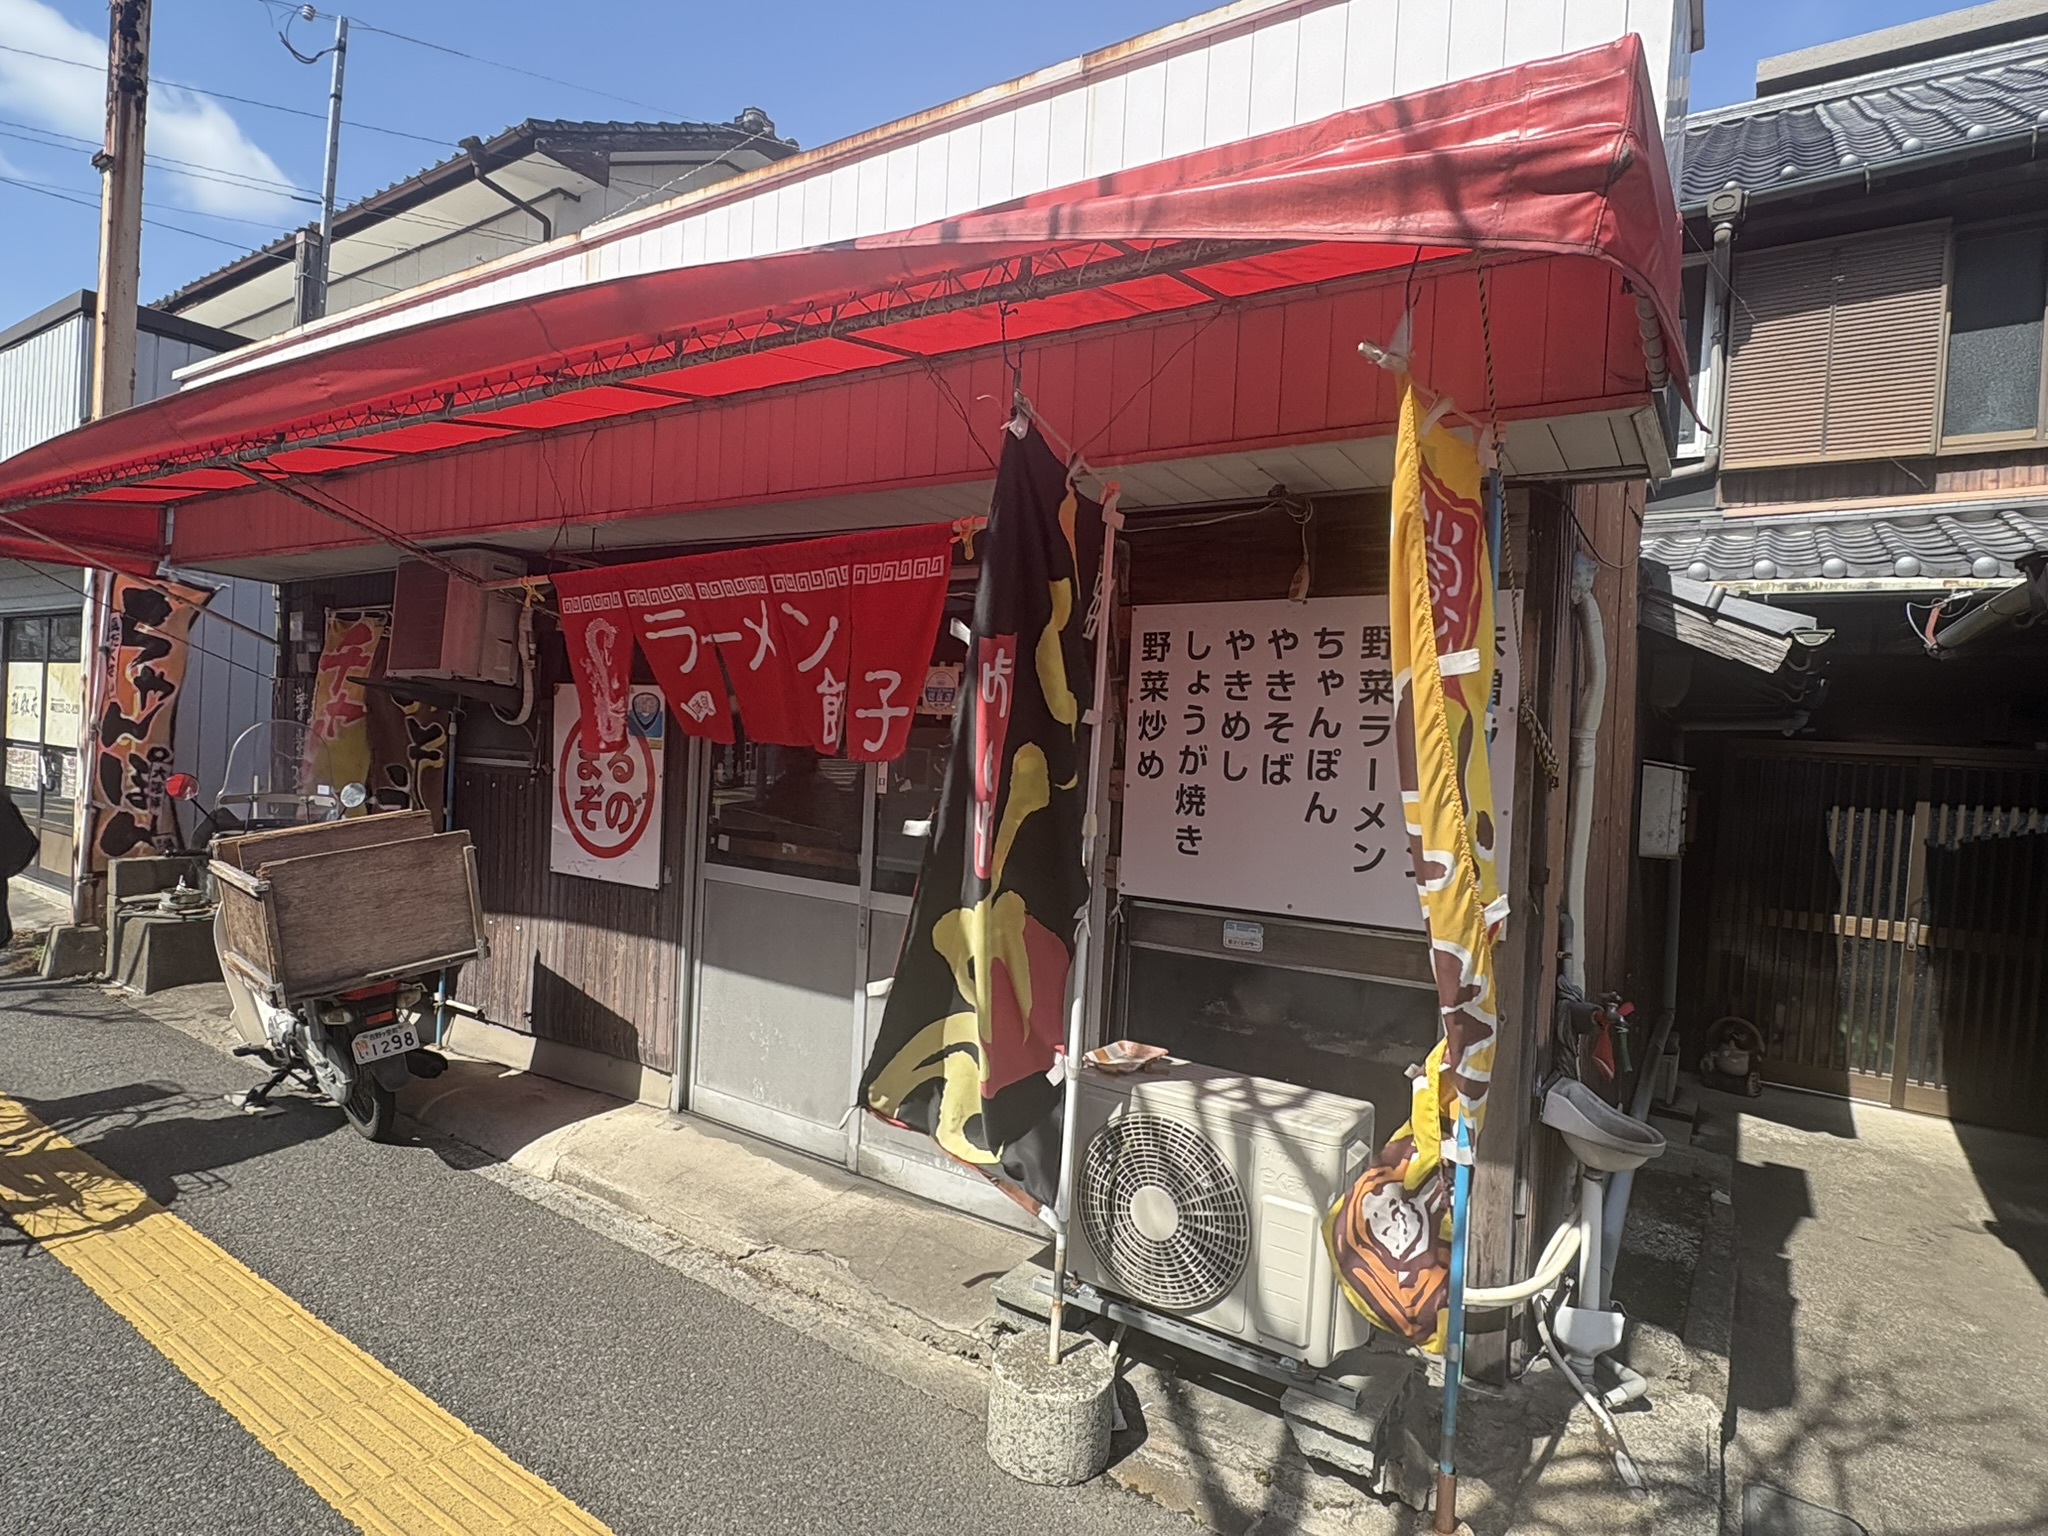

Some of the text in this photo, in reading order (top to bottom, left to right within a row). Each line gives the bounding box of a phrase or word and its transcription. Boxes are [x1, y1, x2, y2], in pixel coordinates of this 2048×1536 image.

[643, 600, 839, 674] ラーメン
[1137, 631, 1172, 780] 野菜炒め
[1220, 628, 1255, 782] やきめし
[1262, 628, 1298, 787] やきそば
[1175, 630, 1212, 856] しょうが焼き
[1304, 627, 1346, 824] ちゃんぽん
[1353, 625, 1394, 873] 野菜ラーメン
[372, 1032, 415, 1056] 1298
